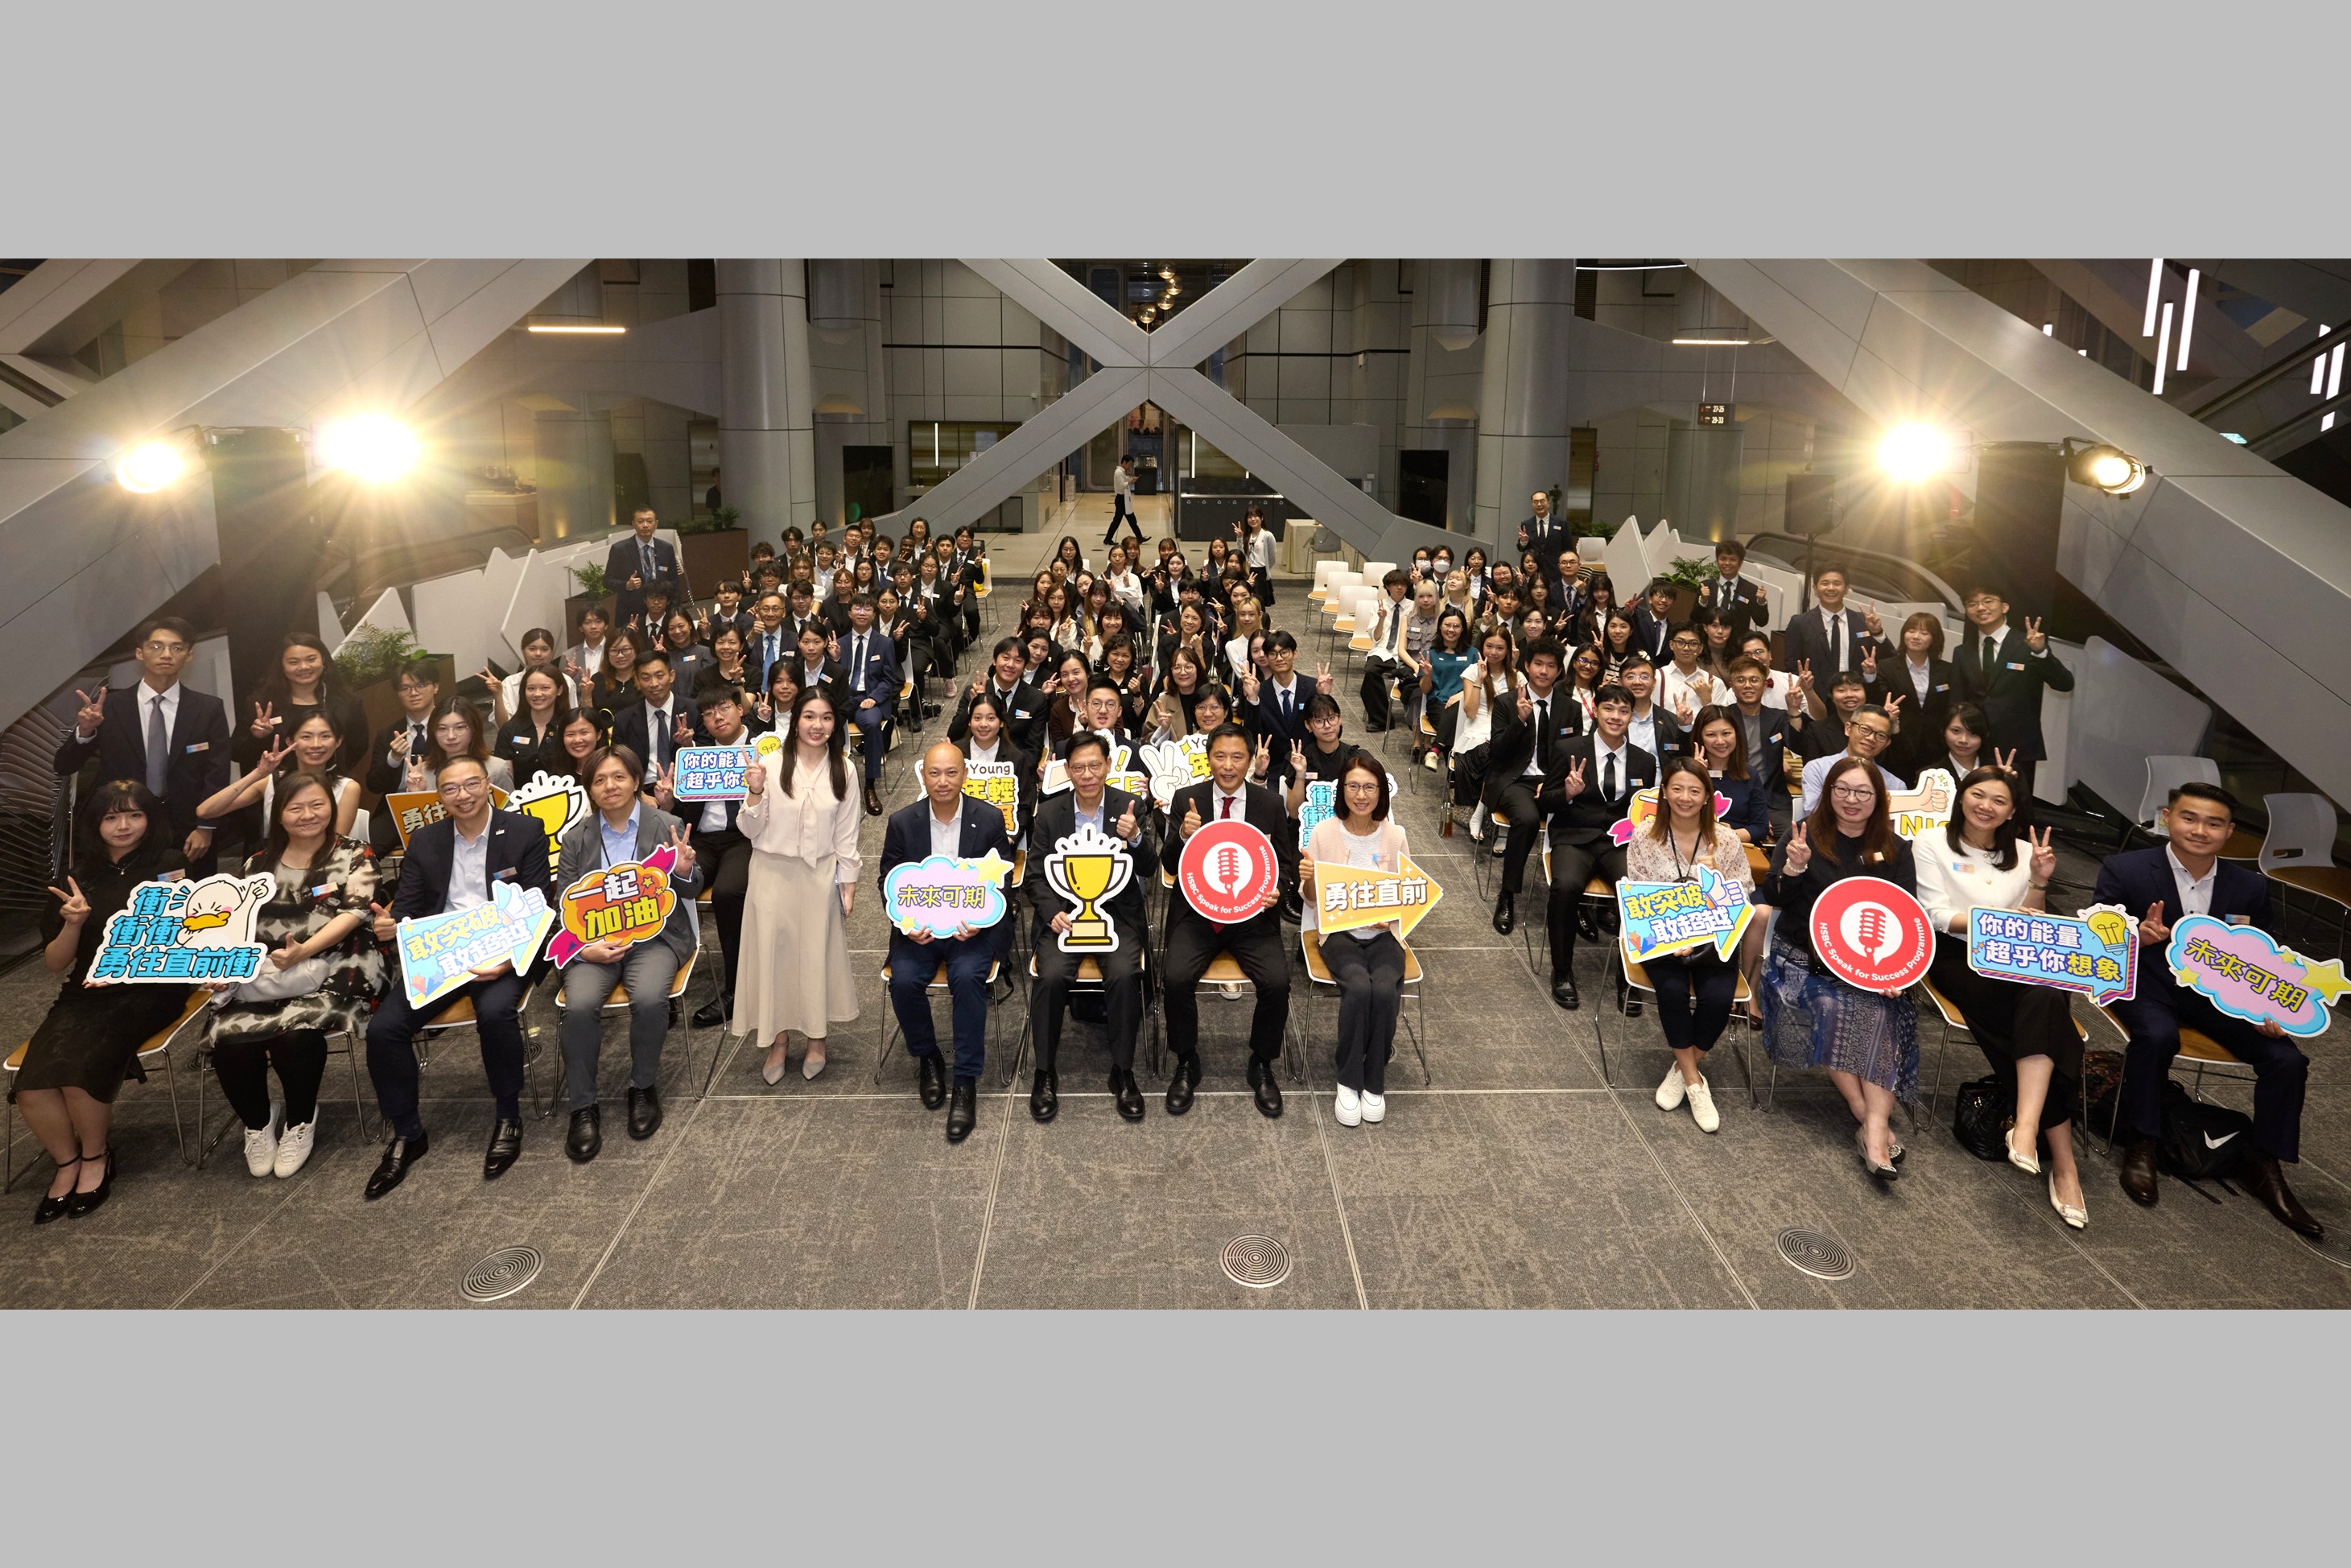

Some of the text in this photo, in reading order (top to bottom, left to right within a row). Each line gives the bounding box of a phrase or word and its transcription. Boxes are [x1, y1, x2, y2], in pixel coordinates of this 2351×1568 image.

[970, 764, 1011, 775] Young
[567, 869, 640, 903] 一起
[897, 884, 985, 909] 未來可期
[1186, 872, 1199, 895] HSBC
[1197, 893, 1219, 912] Speak
[1233, 893, 1262, 913] Success
[1259, 845, 1272, 893] Programme
[1324, 875, 1428, 912] 勇往直前
[133, 885, 171, 917] 衝
[584, 895, 660, 940] 加油
[1623, 883, 1707, 920] 敢突破
[109, 915, 185, 947] 衝衝
[404, 902, 502, 962] 敢突破
[1650, 906, 1735, 943] 敢超越
[1977, 912, 2082, 950] 你的能量
[93, 946, 262, 978] 勇往直前衝
[435, 918, 534, 978] 敢超越
[1819, 917, 1925, 981] HSBC Speak for Success Programme
[1983, 939, 2124, 983] 超乎你想象
[2184, 937, 2309, 1013] 未來可期
